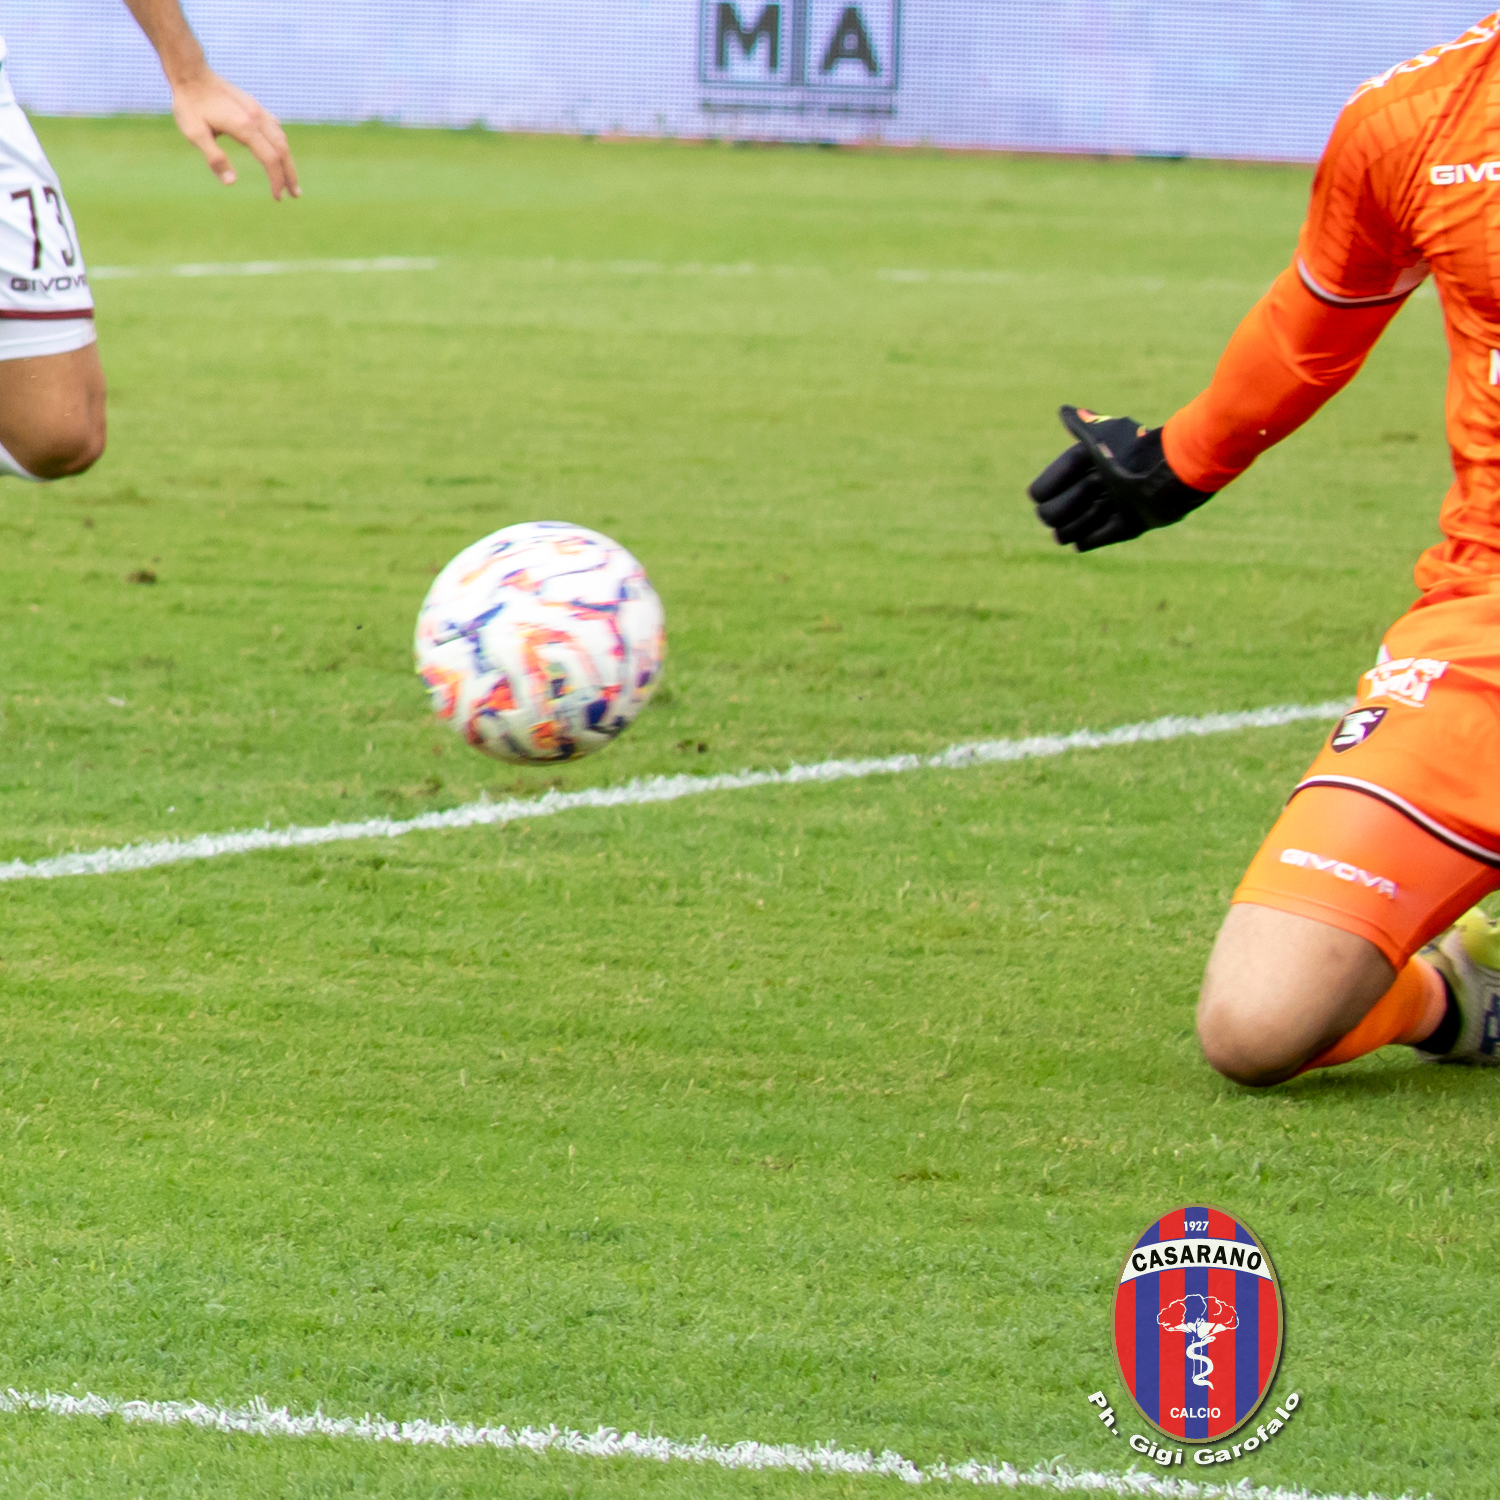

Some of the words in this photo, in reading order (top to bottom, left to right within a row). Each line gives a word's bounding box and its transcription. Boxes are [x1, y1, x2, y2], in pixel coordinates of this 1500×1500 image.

[714, 1, 881, 78] MA
[10, 186, 76, 271] 73
[1280, 847, 1399, 900] GIVOVA
